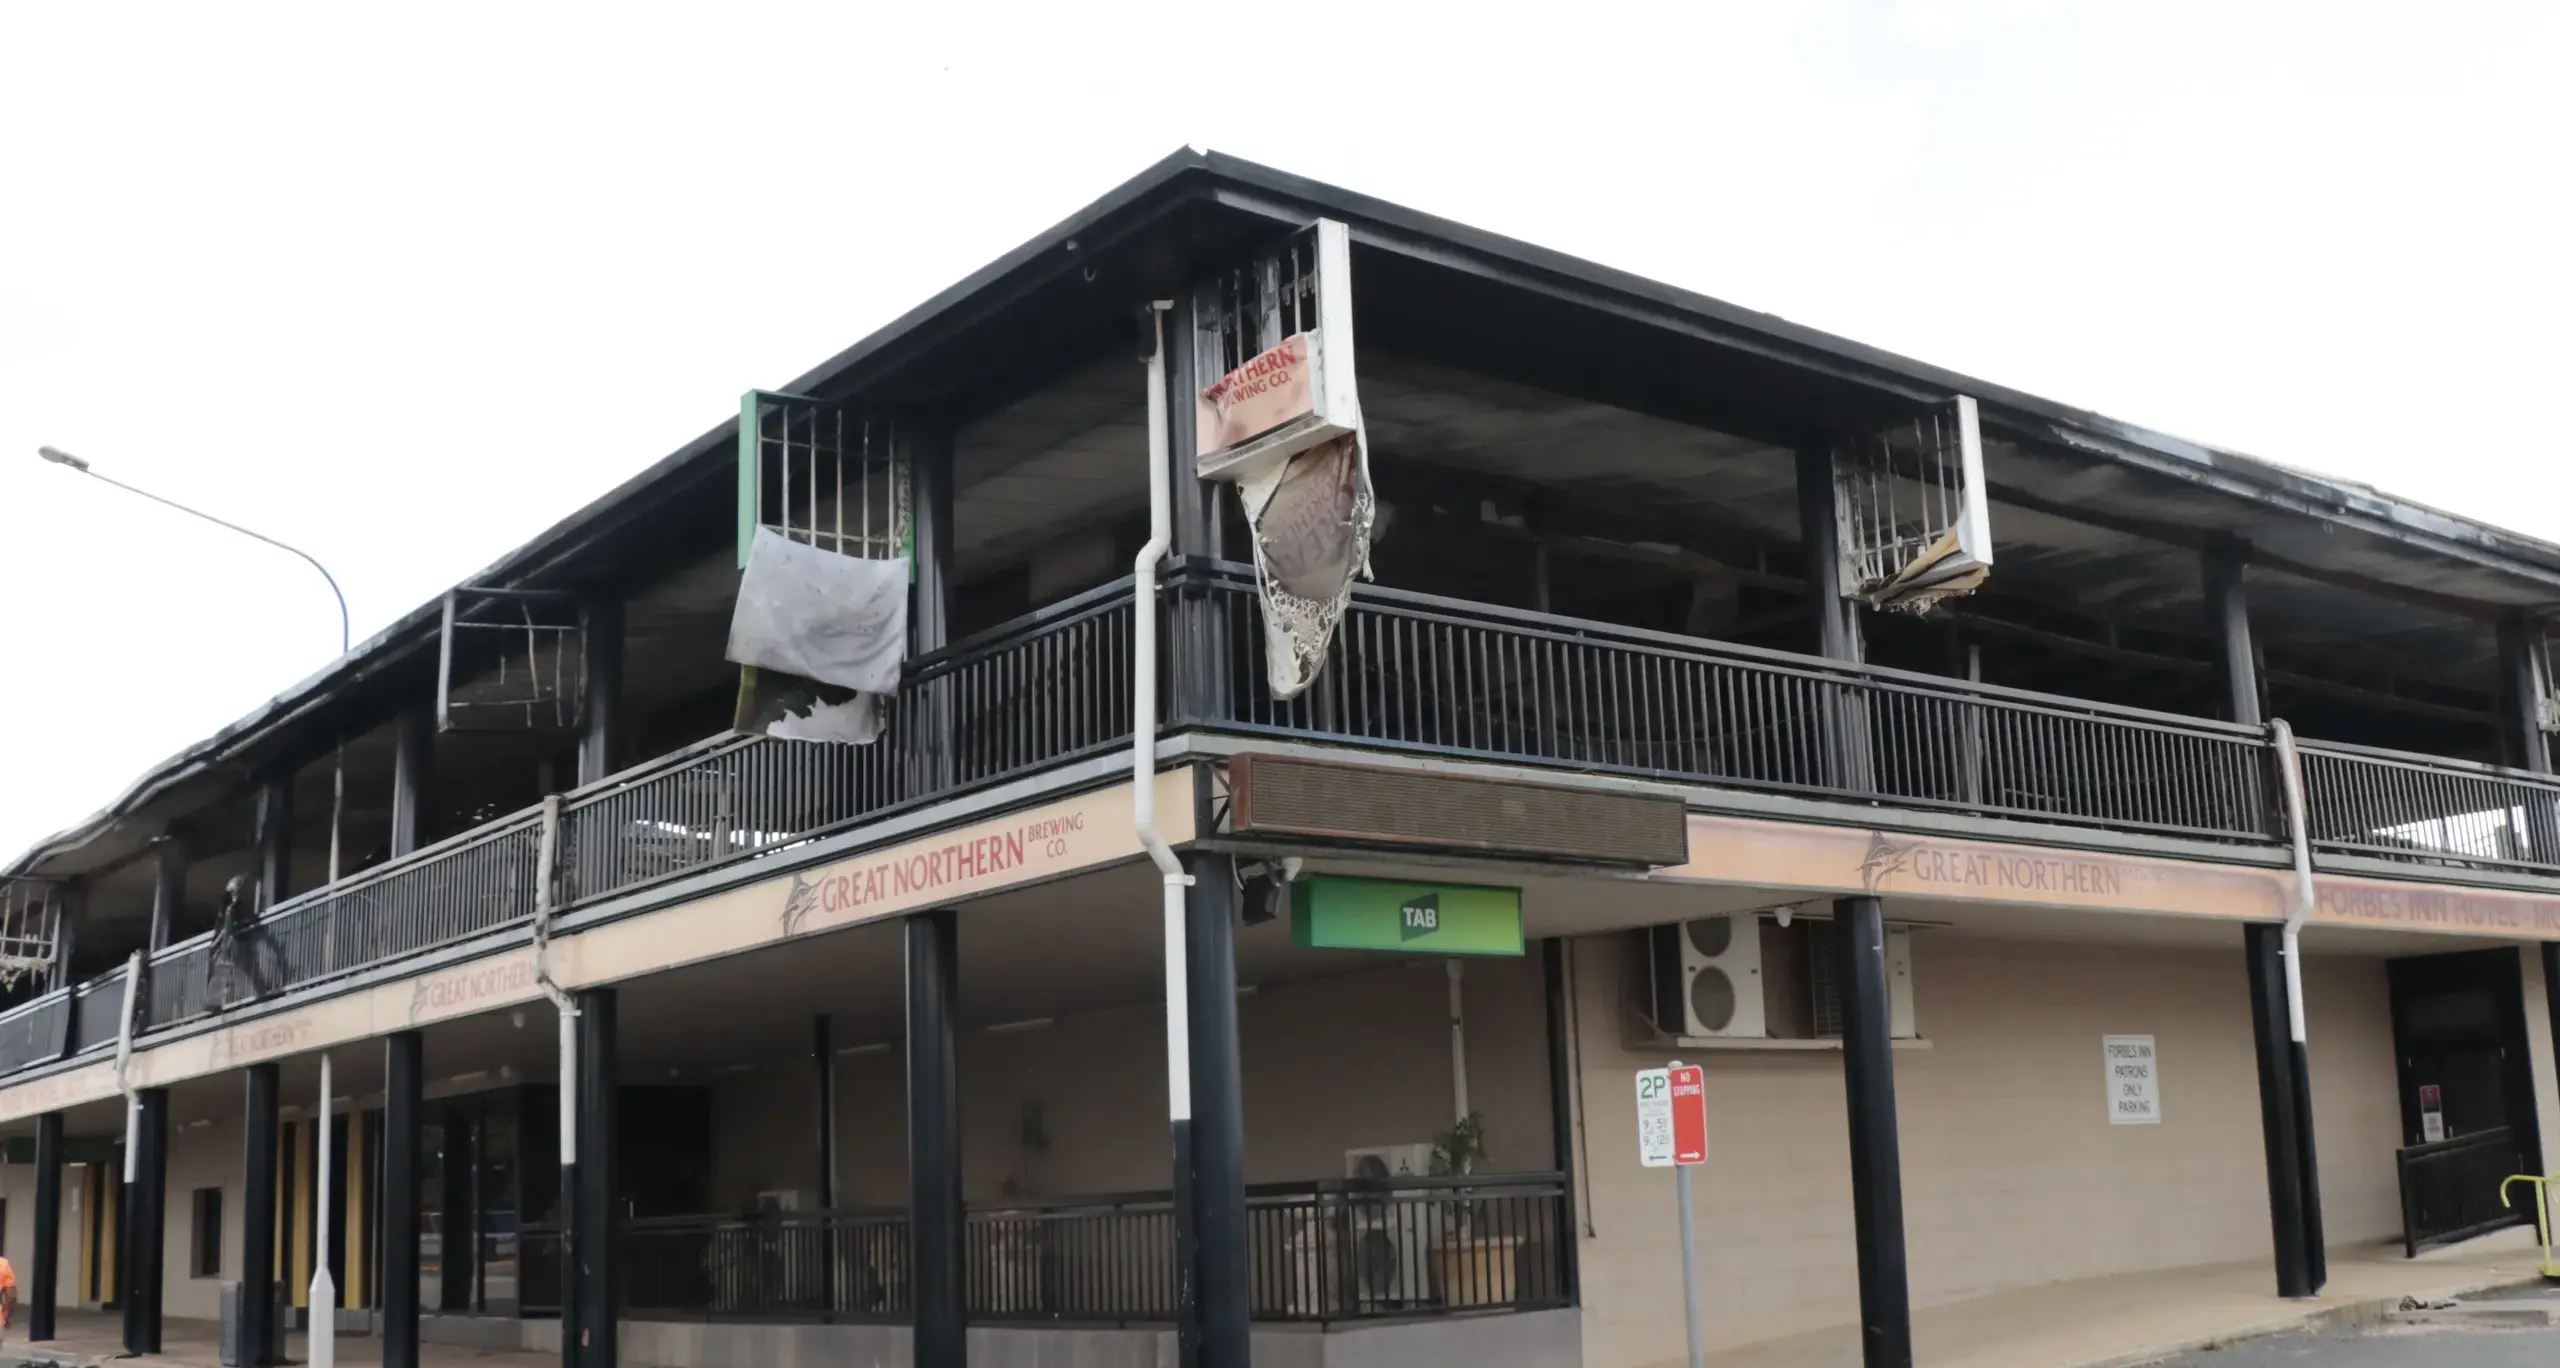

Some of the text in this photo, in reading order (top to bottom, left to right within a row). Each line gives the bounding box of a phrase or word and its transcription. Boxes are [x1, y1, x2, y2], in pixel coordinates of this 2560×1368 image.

[1027, 811, 1085, 844] BREWING
[1046, 838, 1068, 858] CO.
[822, 828, 1025, 913] GREAT NORTHERN
[1913, 849, 1992, 887] GREAT
[1996, 855, 2121, 896] NORTHERN
[2316, 884, 2402, 919] FORBES
[2408, 891, 2448, 923] INN
[2453, 894, 2520, 927] HOTEL
[1403, 907, 1436, 927] TAB
[430, 976, 468, 1008] GREAT
[2108, 1044, 2152, 1059] FORBES INN
[1680, 1072, 1691, 1083] NO
[2115, 1065, 2148, 1078] PATRONS
[1640, 1075, 1665, 1099] 2P
[1672, 1084, 1700, 1096] STOPPING
[2123, 1083, 2142, 1097] ONLY
[2118, 1100, 2151, 1114] PARKING
